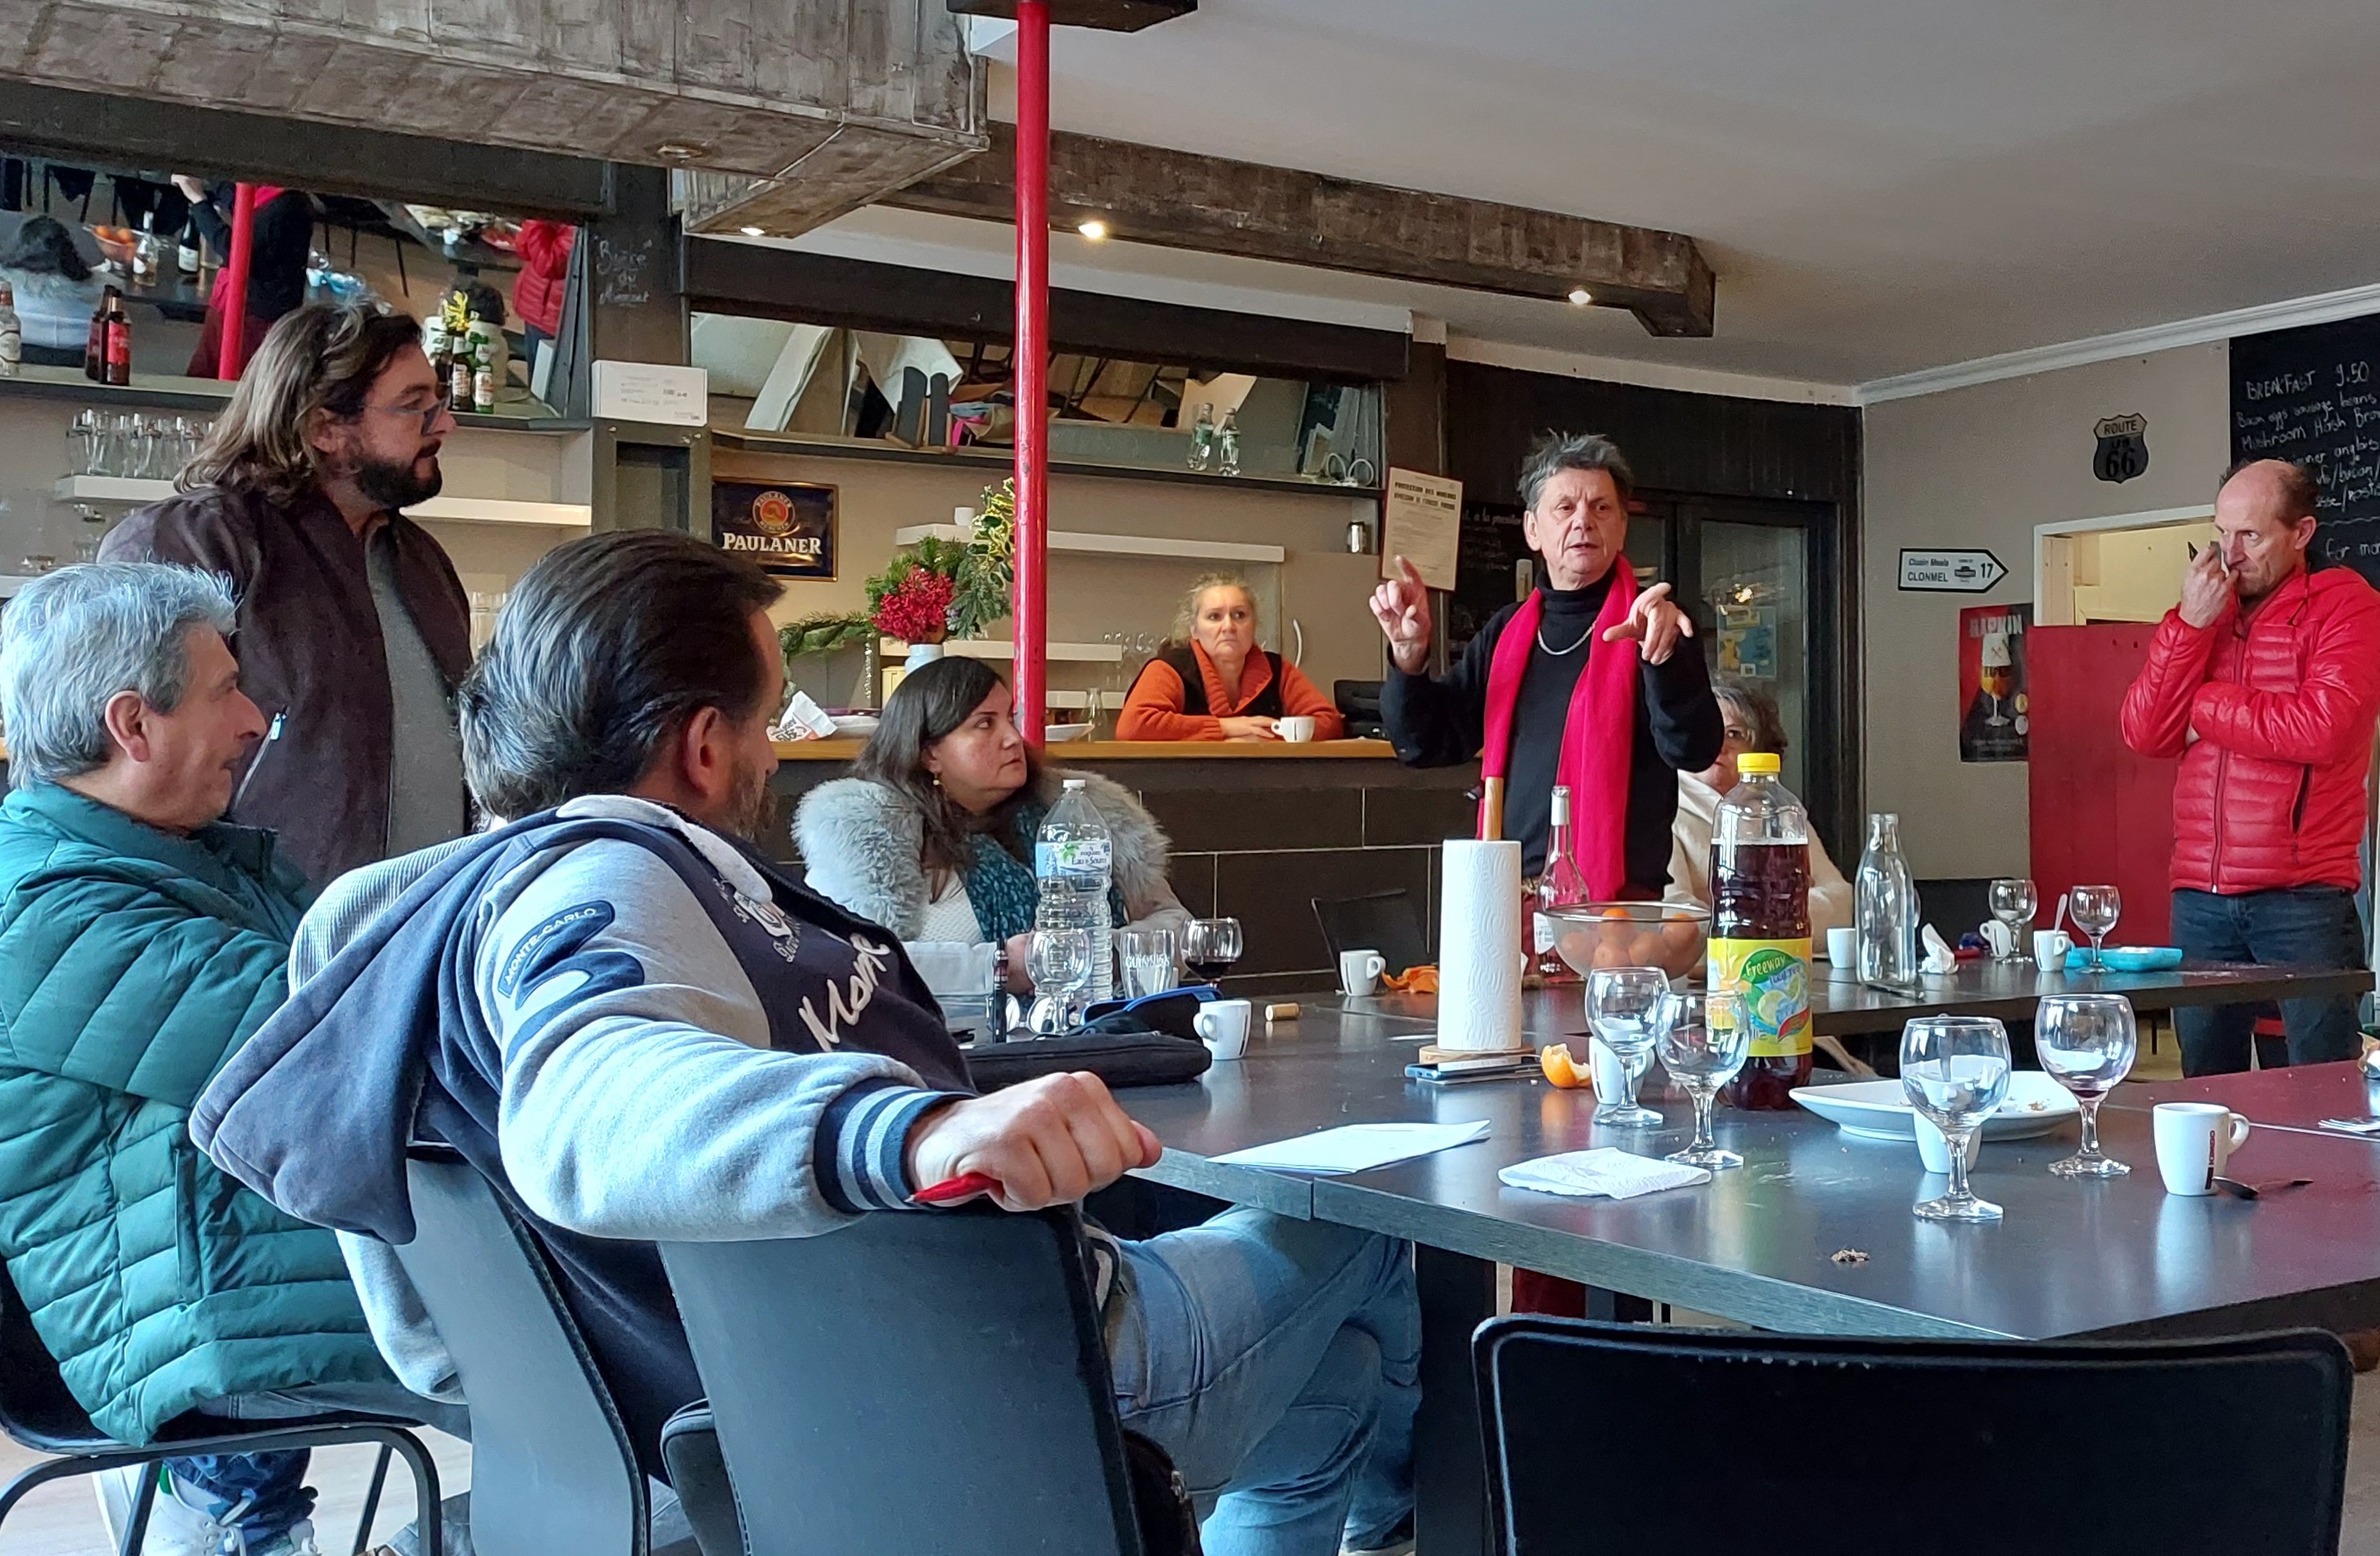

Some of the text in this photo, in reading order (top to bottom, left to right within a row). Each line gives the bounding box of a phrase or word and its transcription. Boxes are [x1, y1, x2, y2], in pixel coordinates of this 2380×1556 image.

[2104, 420, 2137, 435] ROUTE
[2106, 447, 2135, 478] 66
[721, 532, 822, 555] PAULANER
[1907, 572, 1948, 582] CLONMEL
[1980, 562, 1994, 578] 17
[504, 908, 597, 987] MONTE-CARLO
[1745, 955, 1786, 977] Freeway
